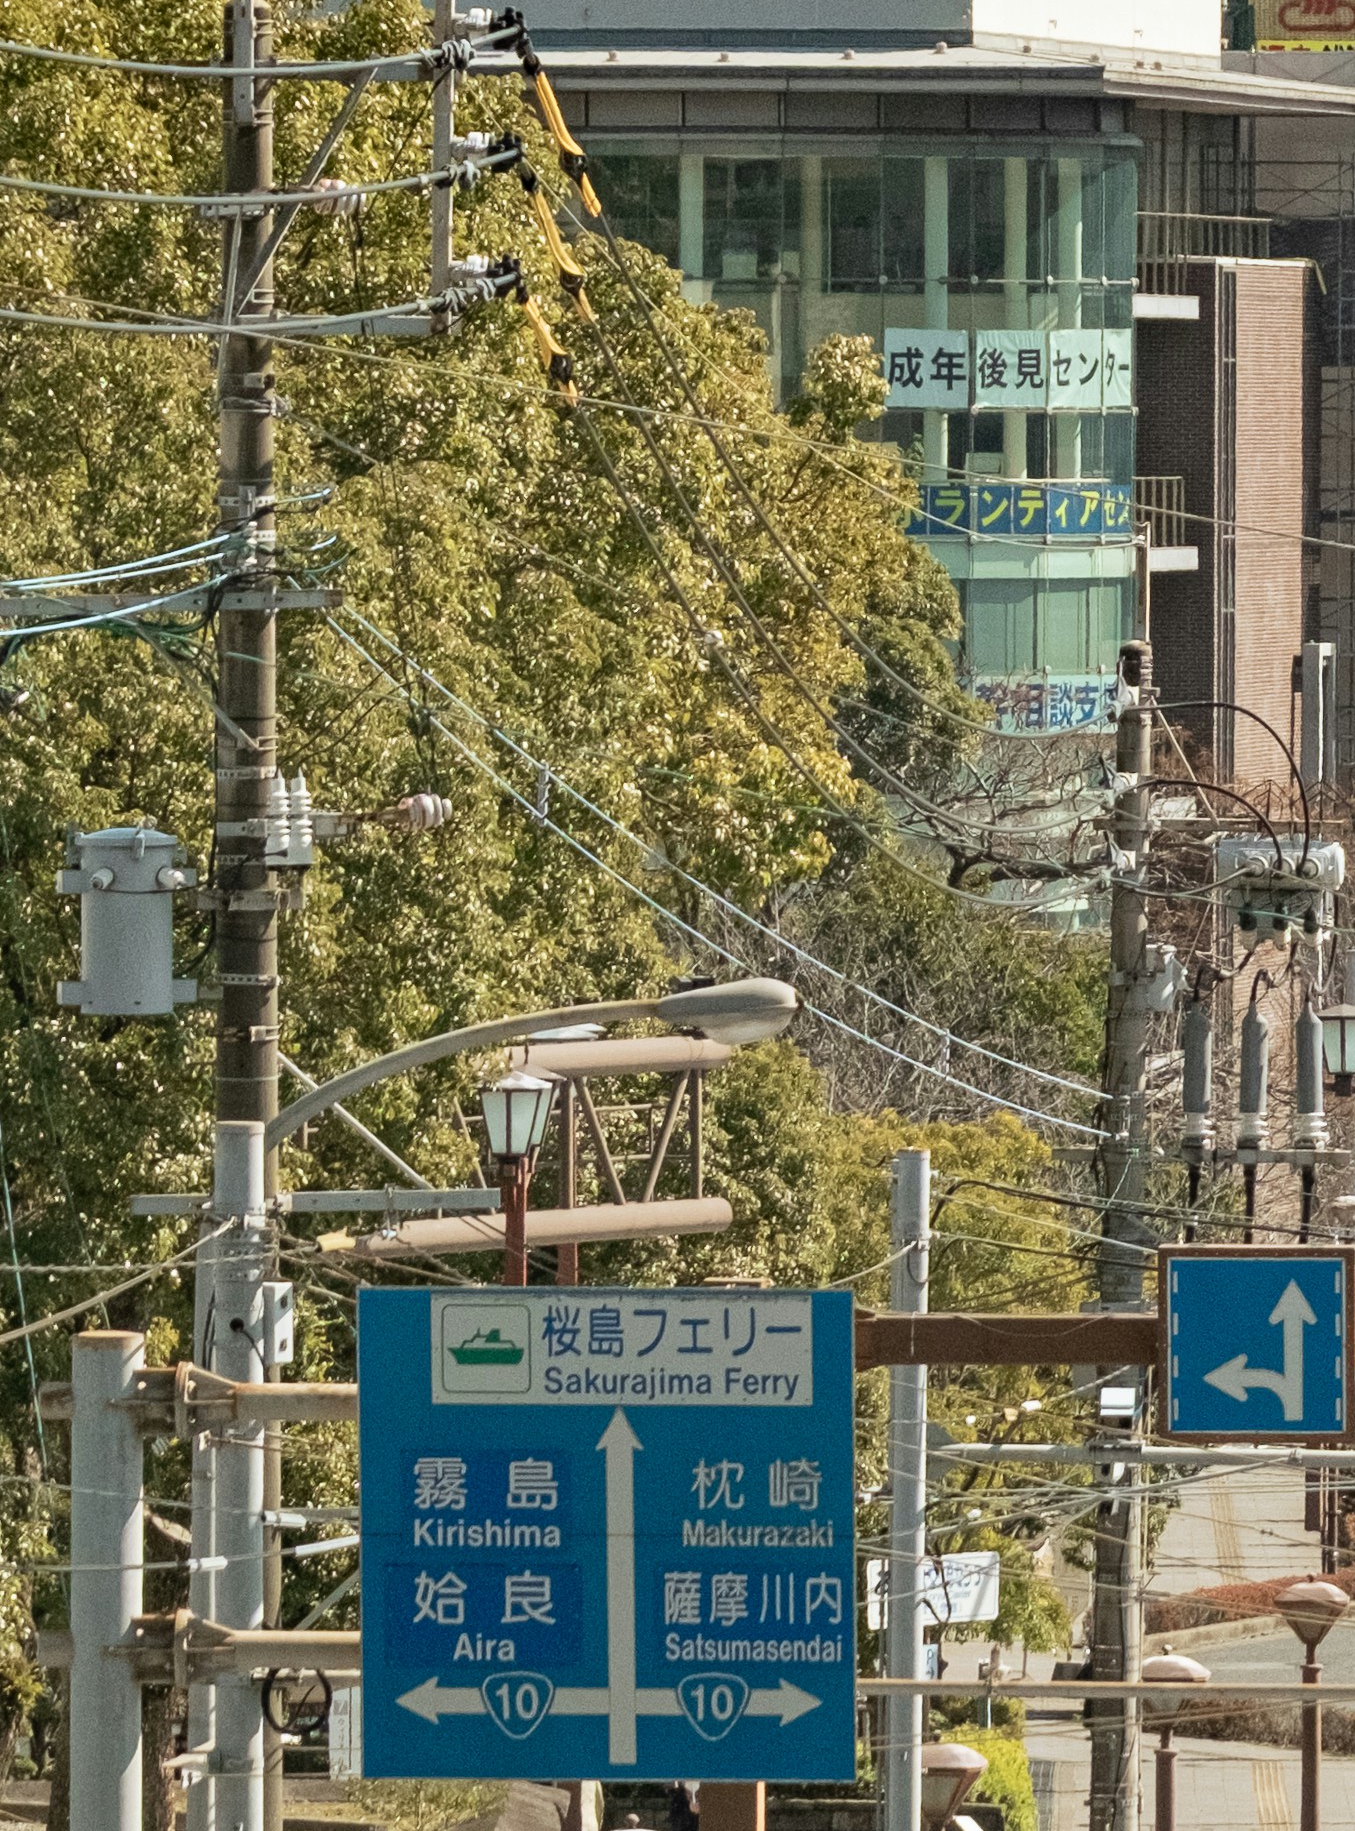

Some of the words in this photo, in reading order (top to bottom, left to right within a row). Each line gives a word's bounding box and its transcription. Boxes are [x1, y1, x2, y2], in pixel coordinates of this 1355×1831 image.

[888, 347, 1130, 391] 成年後見センター
[541, 1304, 802, 1358] 桜島フェリー
[544, 1367, 712, 1400] Sakurajima
[725, 1368, 801, 1400] Ferry
[413, 1457, 559, 1511] 霧島
[690, 1457, 822, 1511] 枕崎
[413, 1518, 561, 1548] Kirishima
[682, 1519, 835, 1548] Makurazaki
[413, 1570, 557, 1626] 姶良
[664, 1571, 842, 1627] 薩摩川内
[453, 1633, 516, 1662] Aira
[665, 1633, 843, 1663] Satsumasendai
[495, 1683, 540, 1722] 10
[690, 1683, 735, 1723] 10
